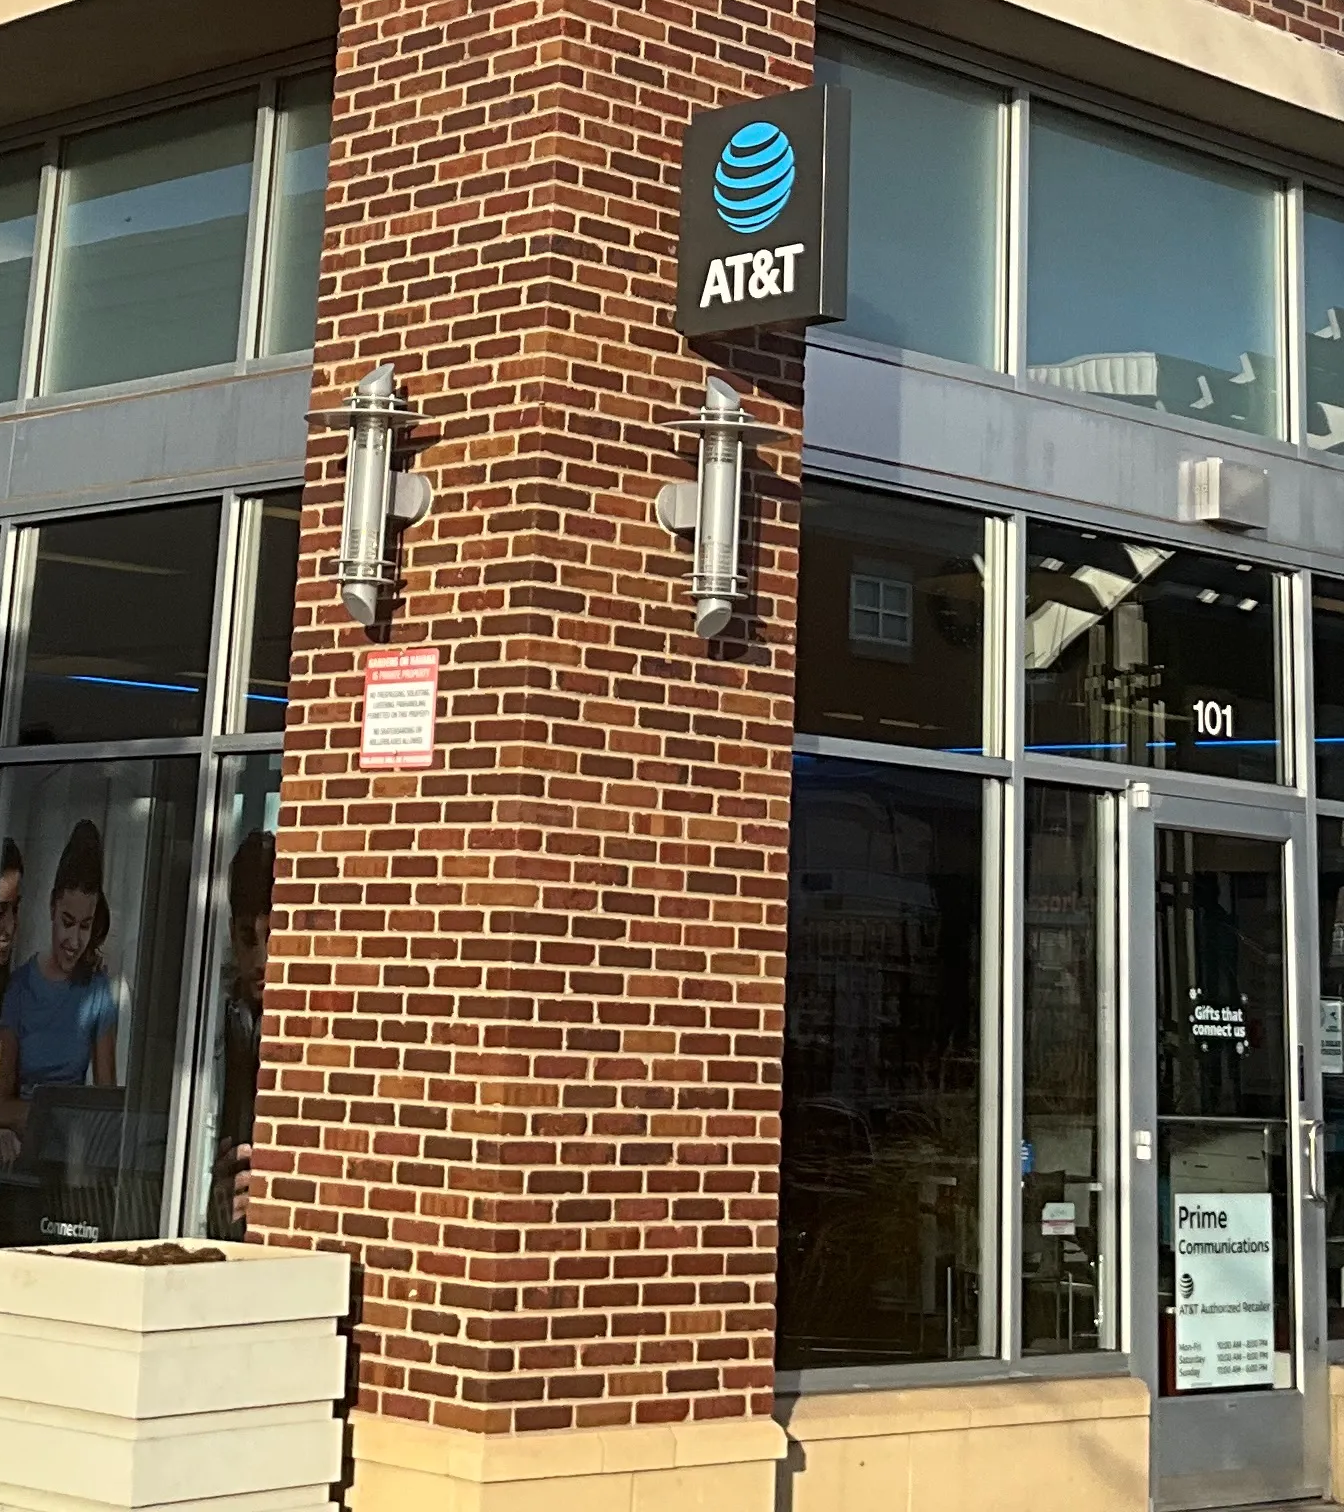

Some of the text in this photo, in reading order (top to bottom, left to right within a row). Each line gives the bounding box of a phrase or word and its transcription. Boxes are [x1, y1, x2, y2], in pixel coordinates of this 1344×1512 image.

[699, 243, 805, 308] AT&T
[1193, 700, 1232, 737] 101
[1194, 1005, 1244, 1022] Gifts that
[1192, 1023, 1246, 1038] connect us
[1178, 1205, 1228, 1229] Prime
[40, 1217, 99, 1243] Connecting
[1178, 1238, 1270, 1255] Communications
[1179, 1300, 1270, 1315] AT&T Authorized Retailer
